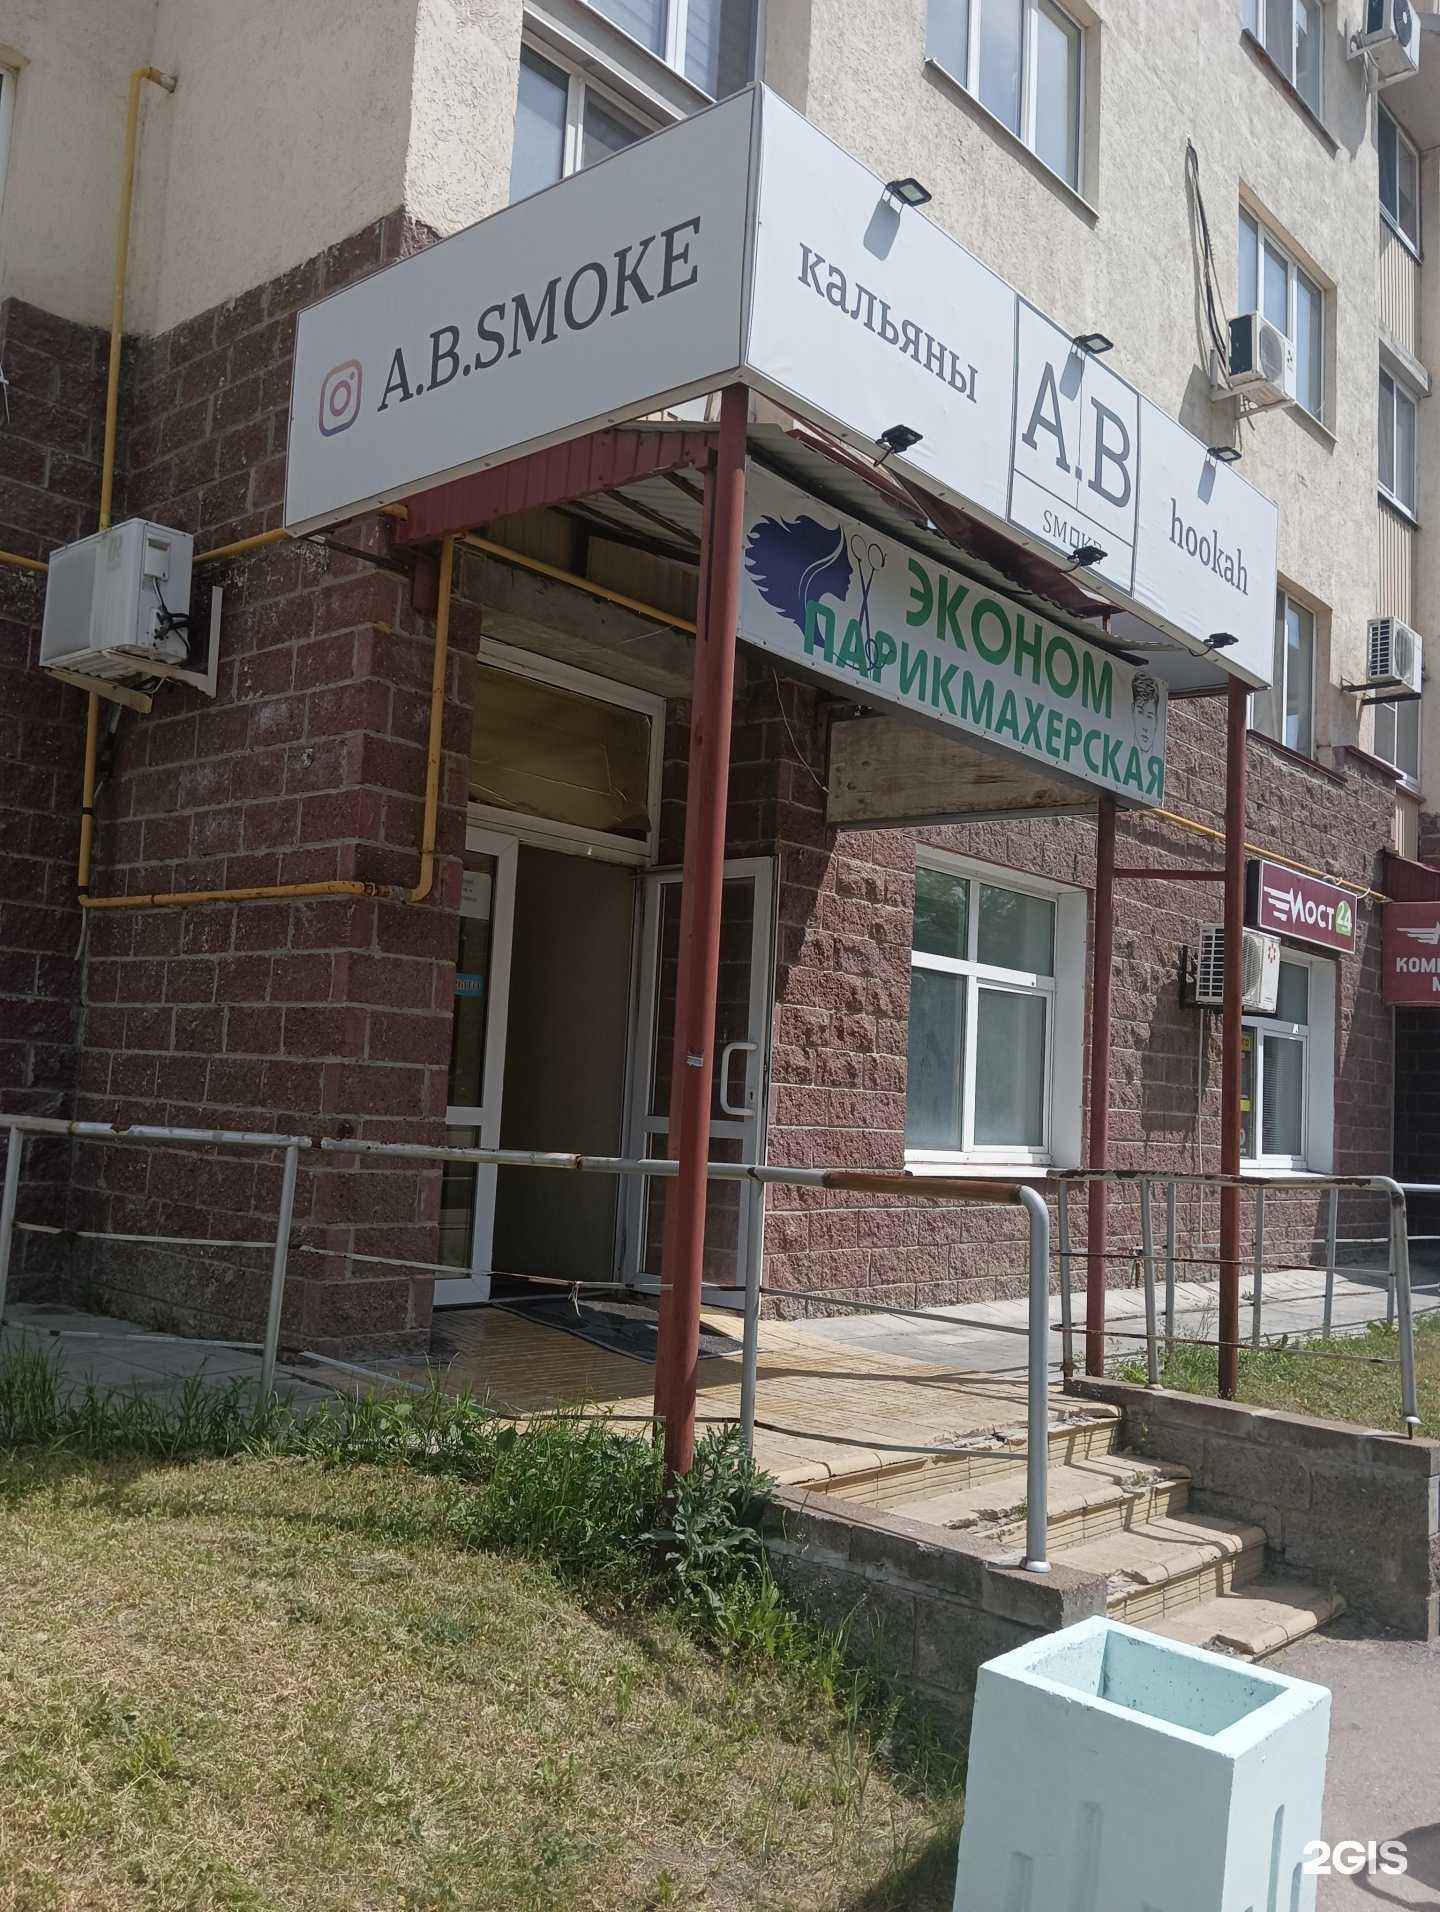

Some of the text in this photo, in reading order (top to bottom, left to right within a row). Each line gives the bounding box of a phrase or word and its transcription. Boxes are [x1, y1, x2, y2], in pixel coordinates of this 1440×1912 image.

[377, 215, 701, 413] A.B.SMOKE
[798, 242, 978, 403] кальяны
[1170, 497, 1248, 596] hookah
[803, 600, 1163, 799] ПАРИКМАХЕРСКАЯ
[906, 557, 1113, 720] ЭКОНОМ
